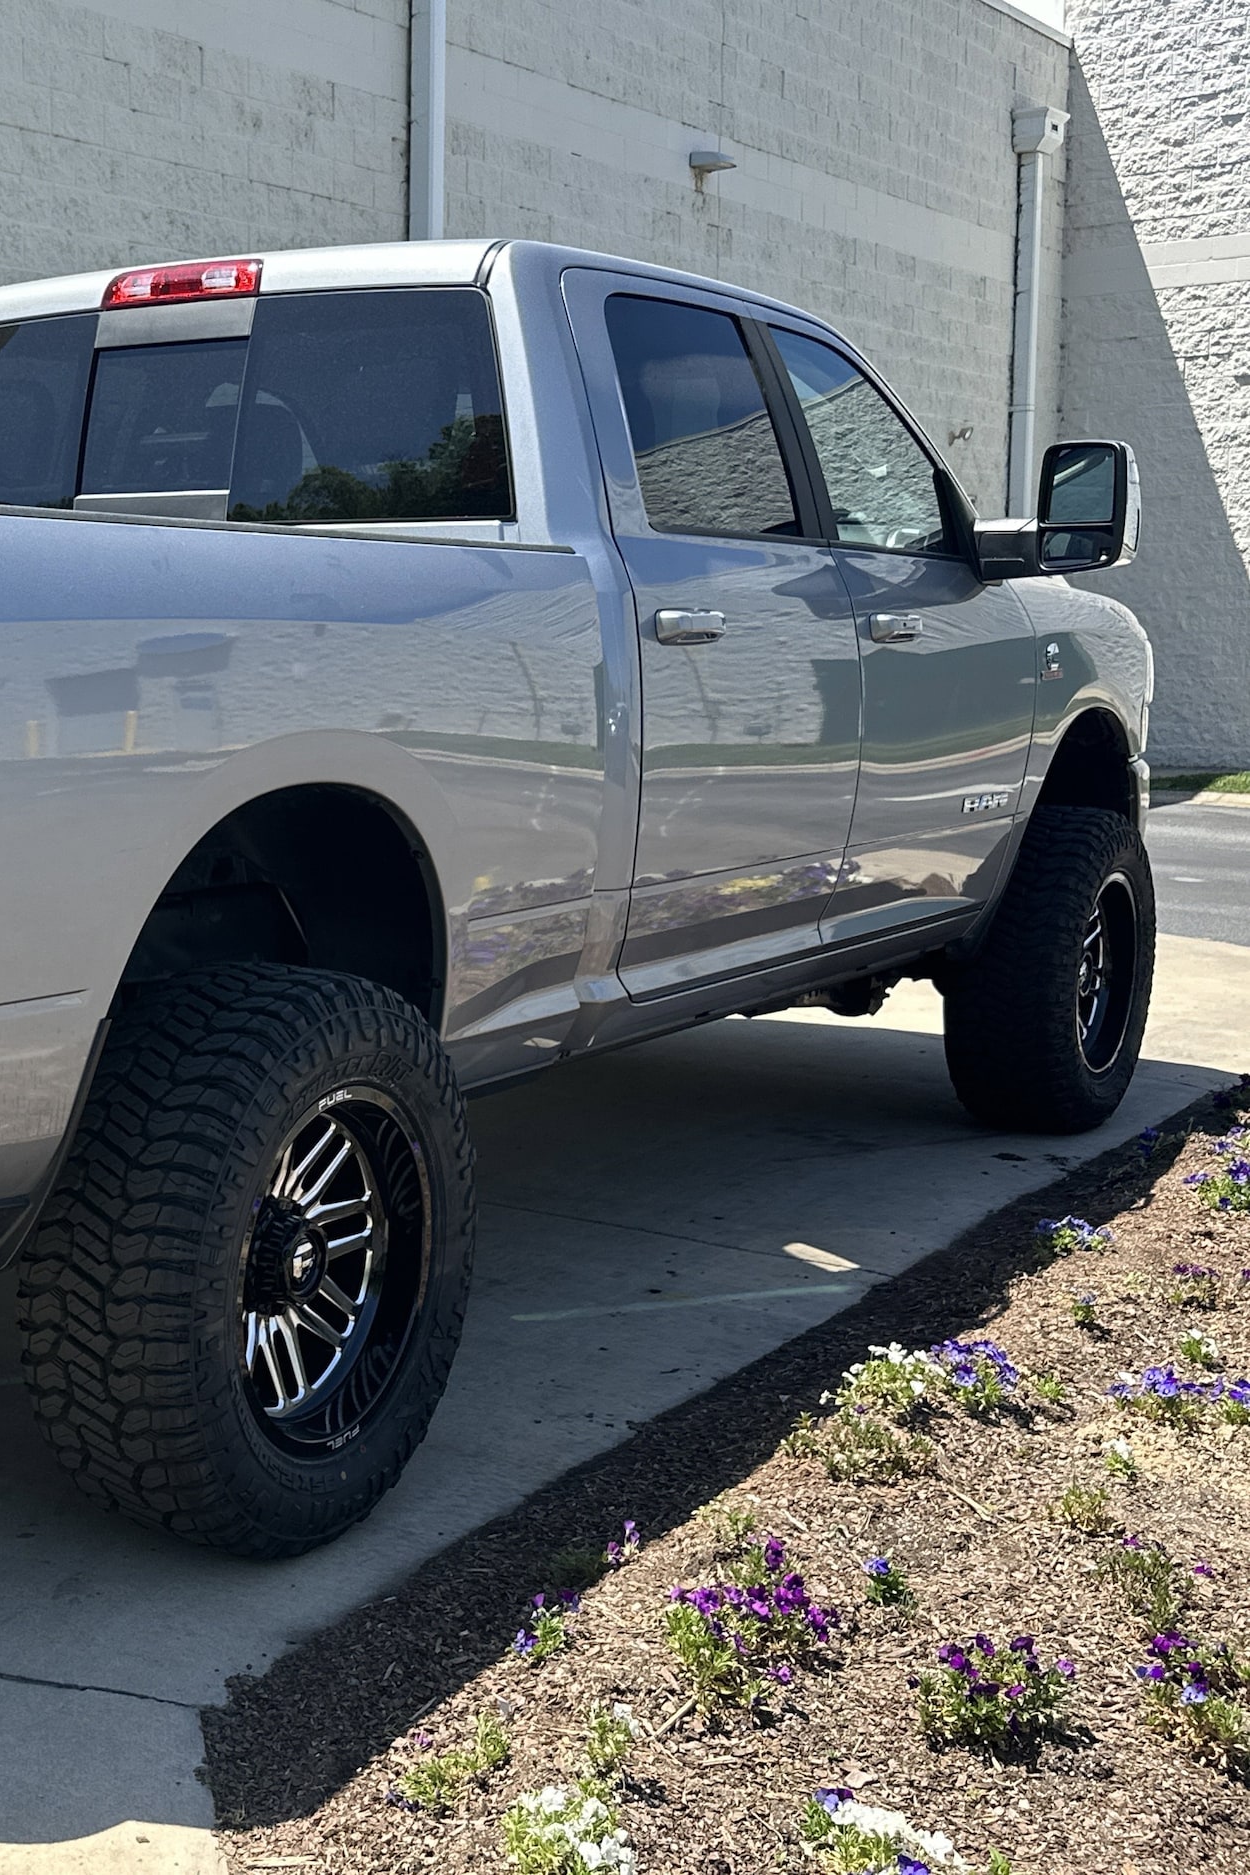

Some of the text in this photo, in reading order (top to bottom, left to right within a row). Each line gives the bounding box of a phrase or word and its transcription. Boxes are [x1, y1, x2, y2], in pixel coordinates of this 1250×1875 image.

[961, 792, 1009, 814] RAM
[318, 1089, 353, 1112] FUEL
[326, 1423, 360, 1451] FUEL
